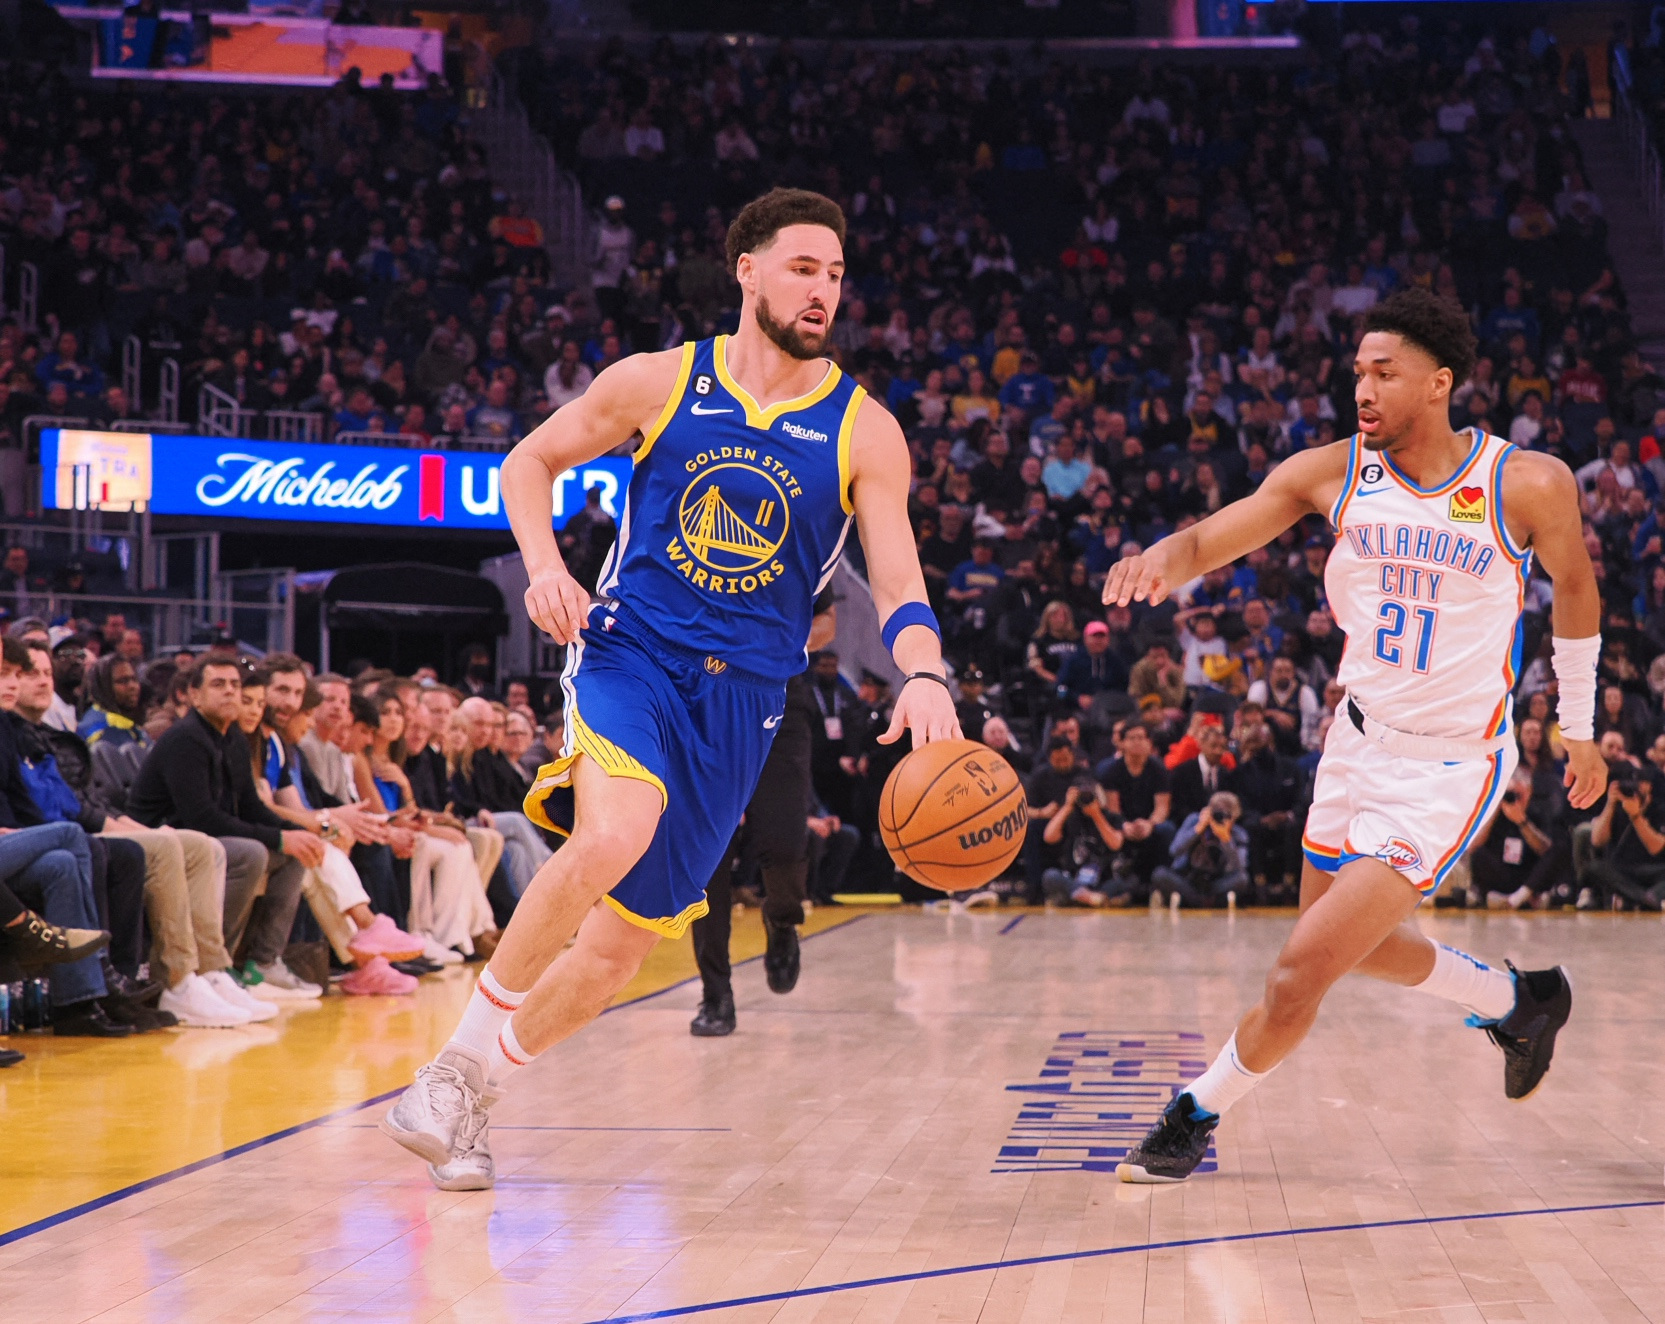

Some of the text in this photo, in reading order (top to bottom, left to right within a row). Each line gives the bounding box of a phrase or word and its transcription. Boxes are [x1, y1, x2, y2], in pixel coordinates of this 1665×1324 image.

[695, 375, 712, 395] 6
[782, 421, 828, 443] Rakuten
[196, 452, 410, 510] Michelob
[685, 446, 803, 499] GOLDEN STATE
[1366, 467, 1379, 482] 6
[1451, 508, 1482, 521] Love's
[665, 536, 785, 594] WARRIORS
[1343, 523, 1496, 580] OKLAHOMA
[1380, 562, 1444, 602] CITY
[1373, 600, 1439, 675] 21
[706, 655, 726, 673] W
[958, 796, 1028, 850] Wilson
[1376, 845, 1416, 862] OKC
